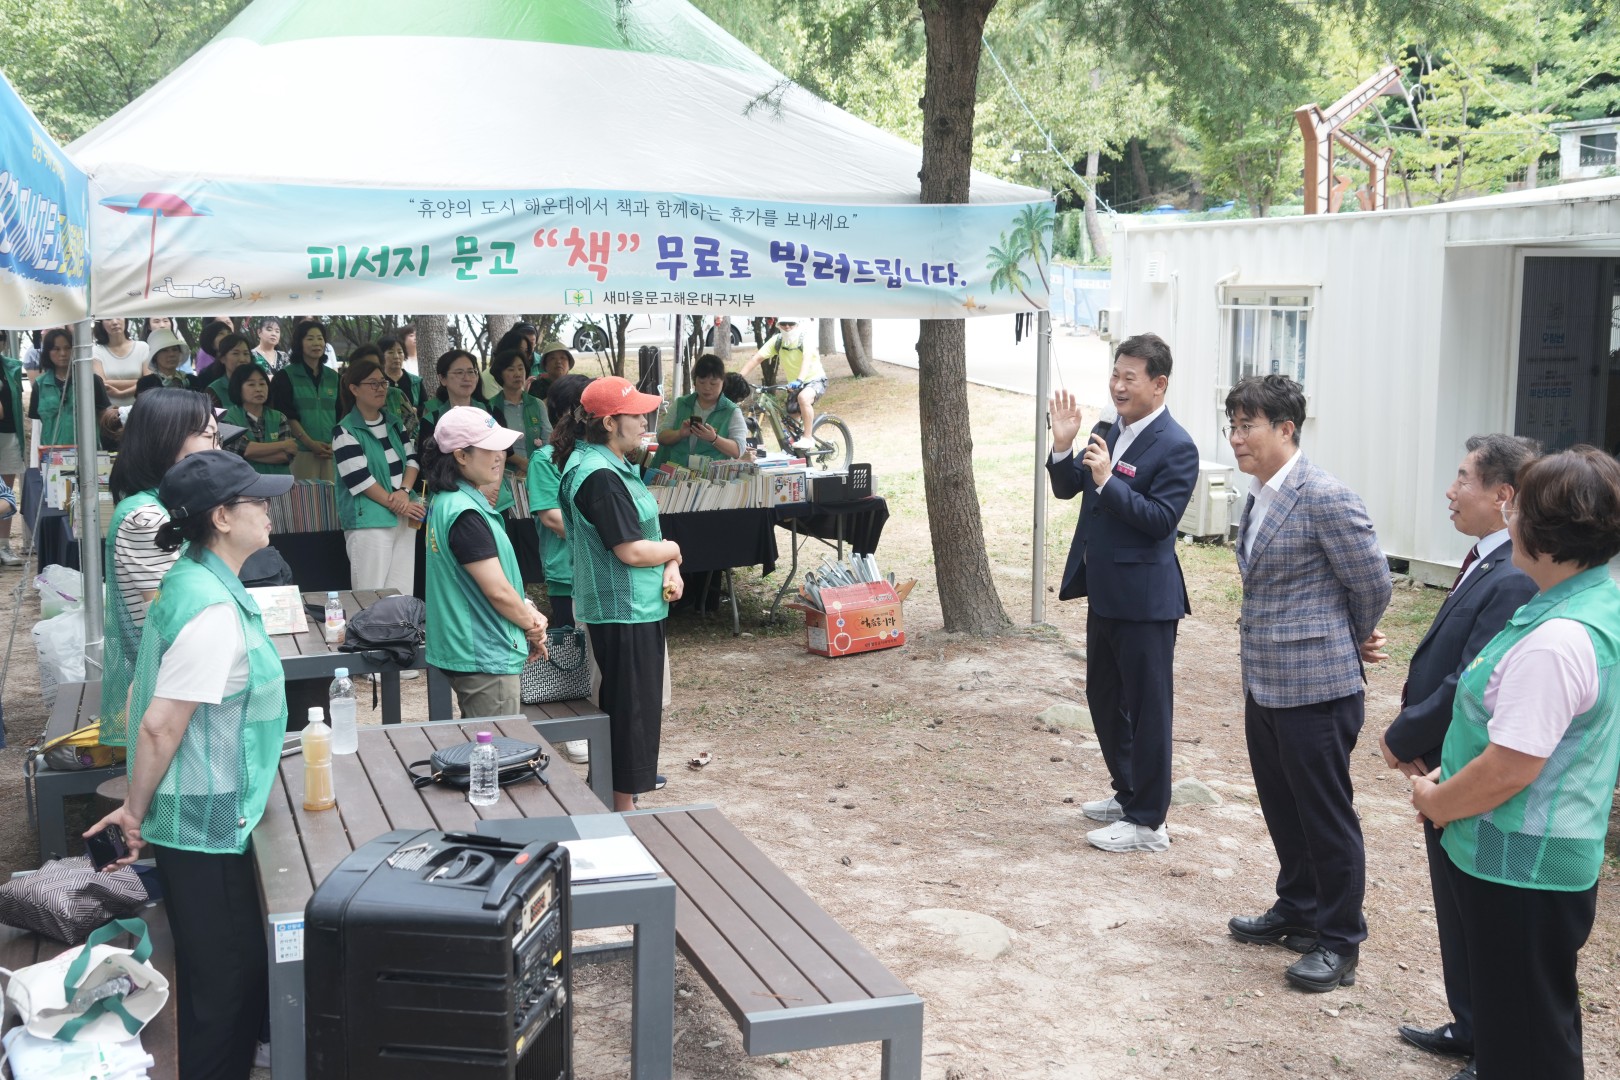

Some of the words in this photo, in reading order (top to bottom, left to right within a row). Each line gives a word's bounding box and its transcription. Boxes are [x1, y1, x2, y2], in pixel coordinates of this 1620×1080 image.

[480, 198, 516, 216] 도시
[523, 196, 608, 216] 해운대에서
[616, 198, 650, 218] 책과
[655, 199, 723, 222] 함께하는
[729, 206, 779, 227] 휴가를
[307, 244, 430, 280] 피서지
[451, 235, 519, 281] 문고
[655, 234, 752, 282] 무료로
[769, 240, 968, 289] 빌려드립니다.
[603, 290, 756, 307] 새마을문고해운대구지부
